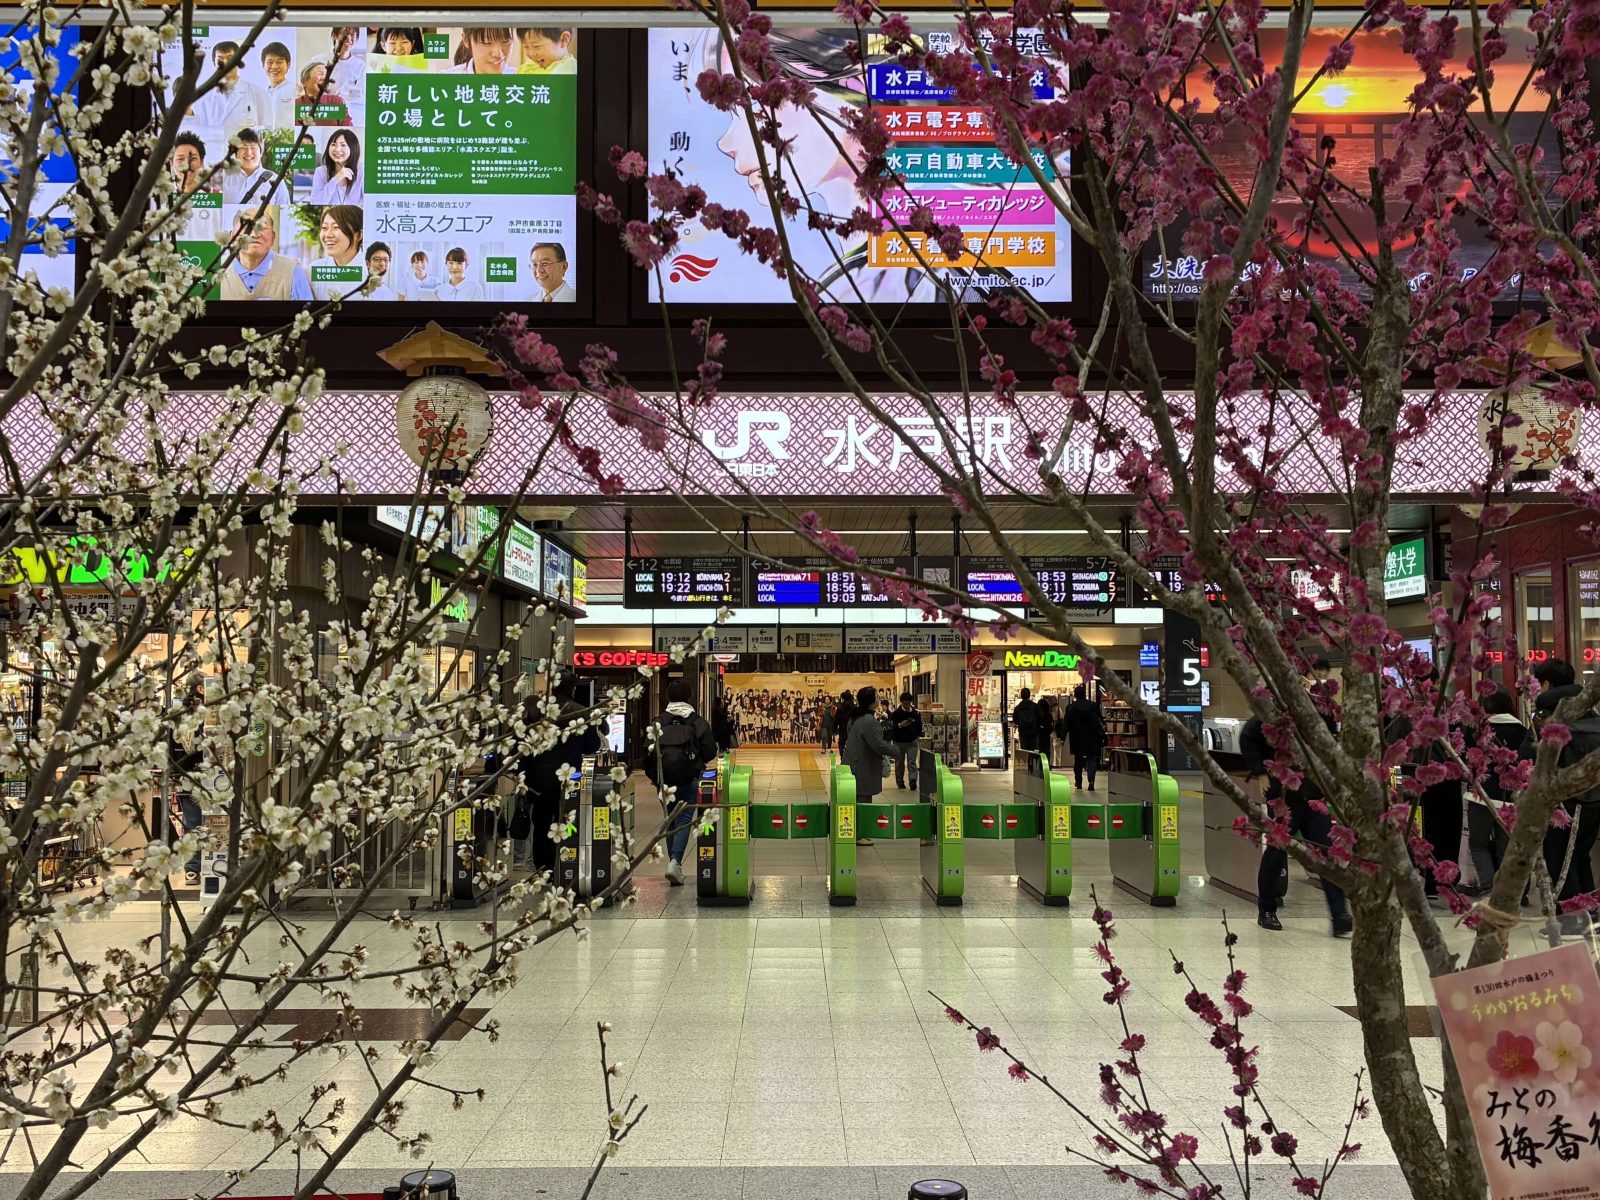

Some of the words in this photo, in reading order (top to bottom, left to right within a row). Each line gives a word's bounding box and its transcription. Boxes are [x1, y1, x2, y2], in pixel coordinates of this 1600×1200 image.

[378, 84, 550, 104] 新しい地域交流
[378, 109, 513, 128] の場として。
[886, 194, 1045, 212] 水戸ビューティカレッジ
[375, 214, 493, 234] 水高スクエア
[886, 236, 1046, 255] 水戸看専門学校
[702, 411, 791, 460] JR
[823, 414, 1013, 473] 水戸駅
[635, 573, 654, 581] LOCAL
[660, 572, 691, 582] 19:12
[723, 572, 731, 582] 2
[826, 572, 855, 582] 18:51
[1036, 572, 1066, 582] 18:53
[1108, 572, 1115, 582] 7
[635, 584, 654, 592] LOCAL
[660, 583, 691, 593] 19:22
[725, 583, 730, 592] 1
[757, 583, 776, 591] LOCAL
[826, 583, 856, 592] 18:56
[967, 583, 986, 592] LOCAL
[1108, 582, 1116, 592] 5
[757, 594, 776, 602] LOCAL
[826, 593, 856, 603] 19:03
[1108, 593, 1115, 603] 7
[925, 634, 931, 642] 7
[954, 634, 960, 642] 8
[600, 652, 669, 666] COFFEE
[1182, 658, 1200, 686] 5
[967, 677, 984, 721] 駅弁
[1471, 984, 1573, 1022] うめかおるみち
[1486, 1087, 1556, 1119] みとの
